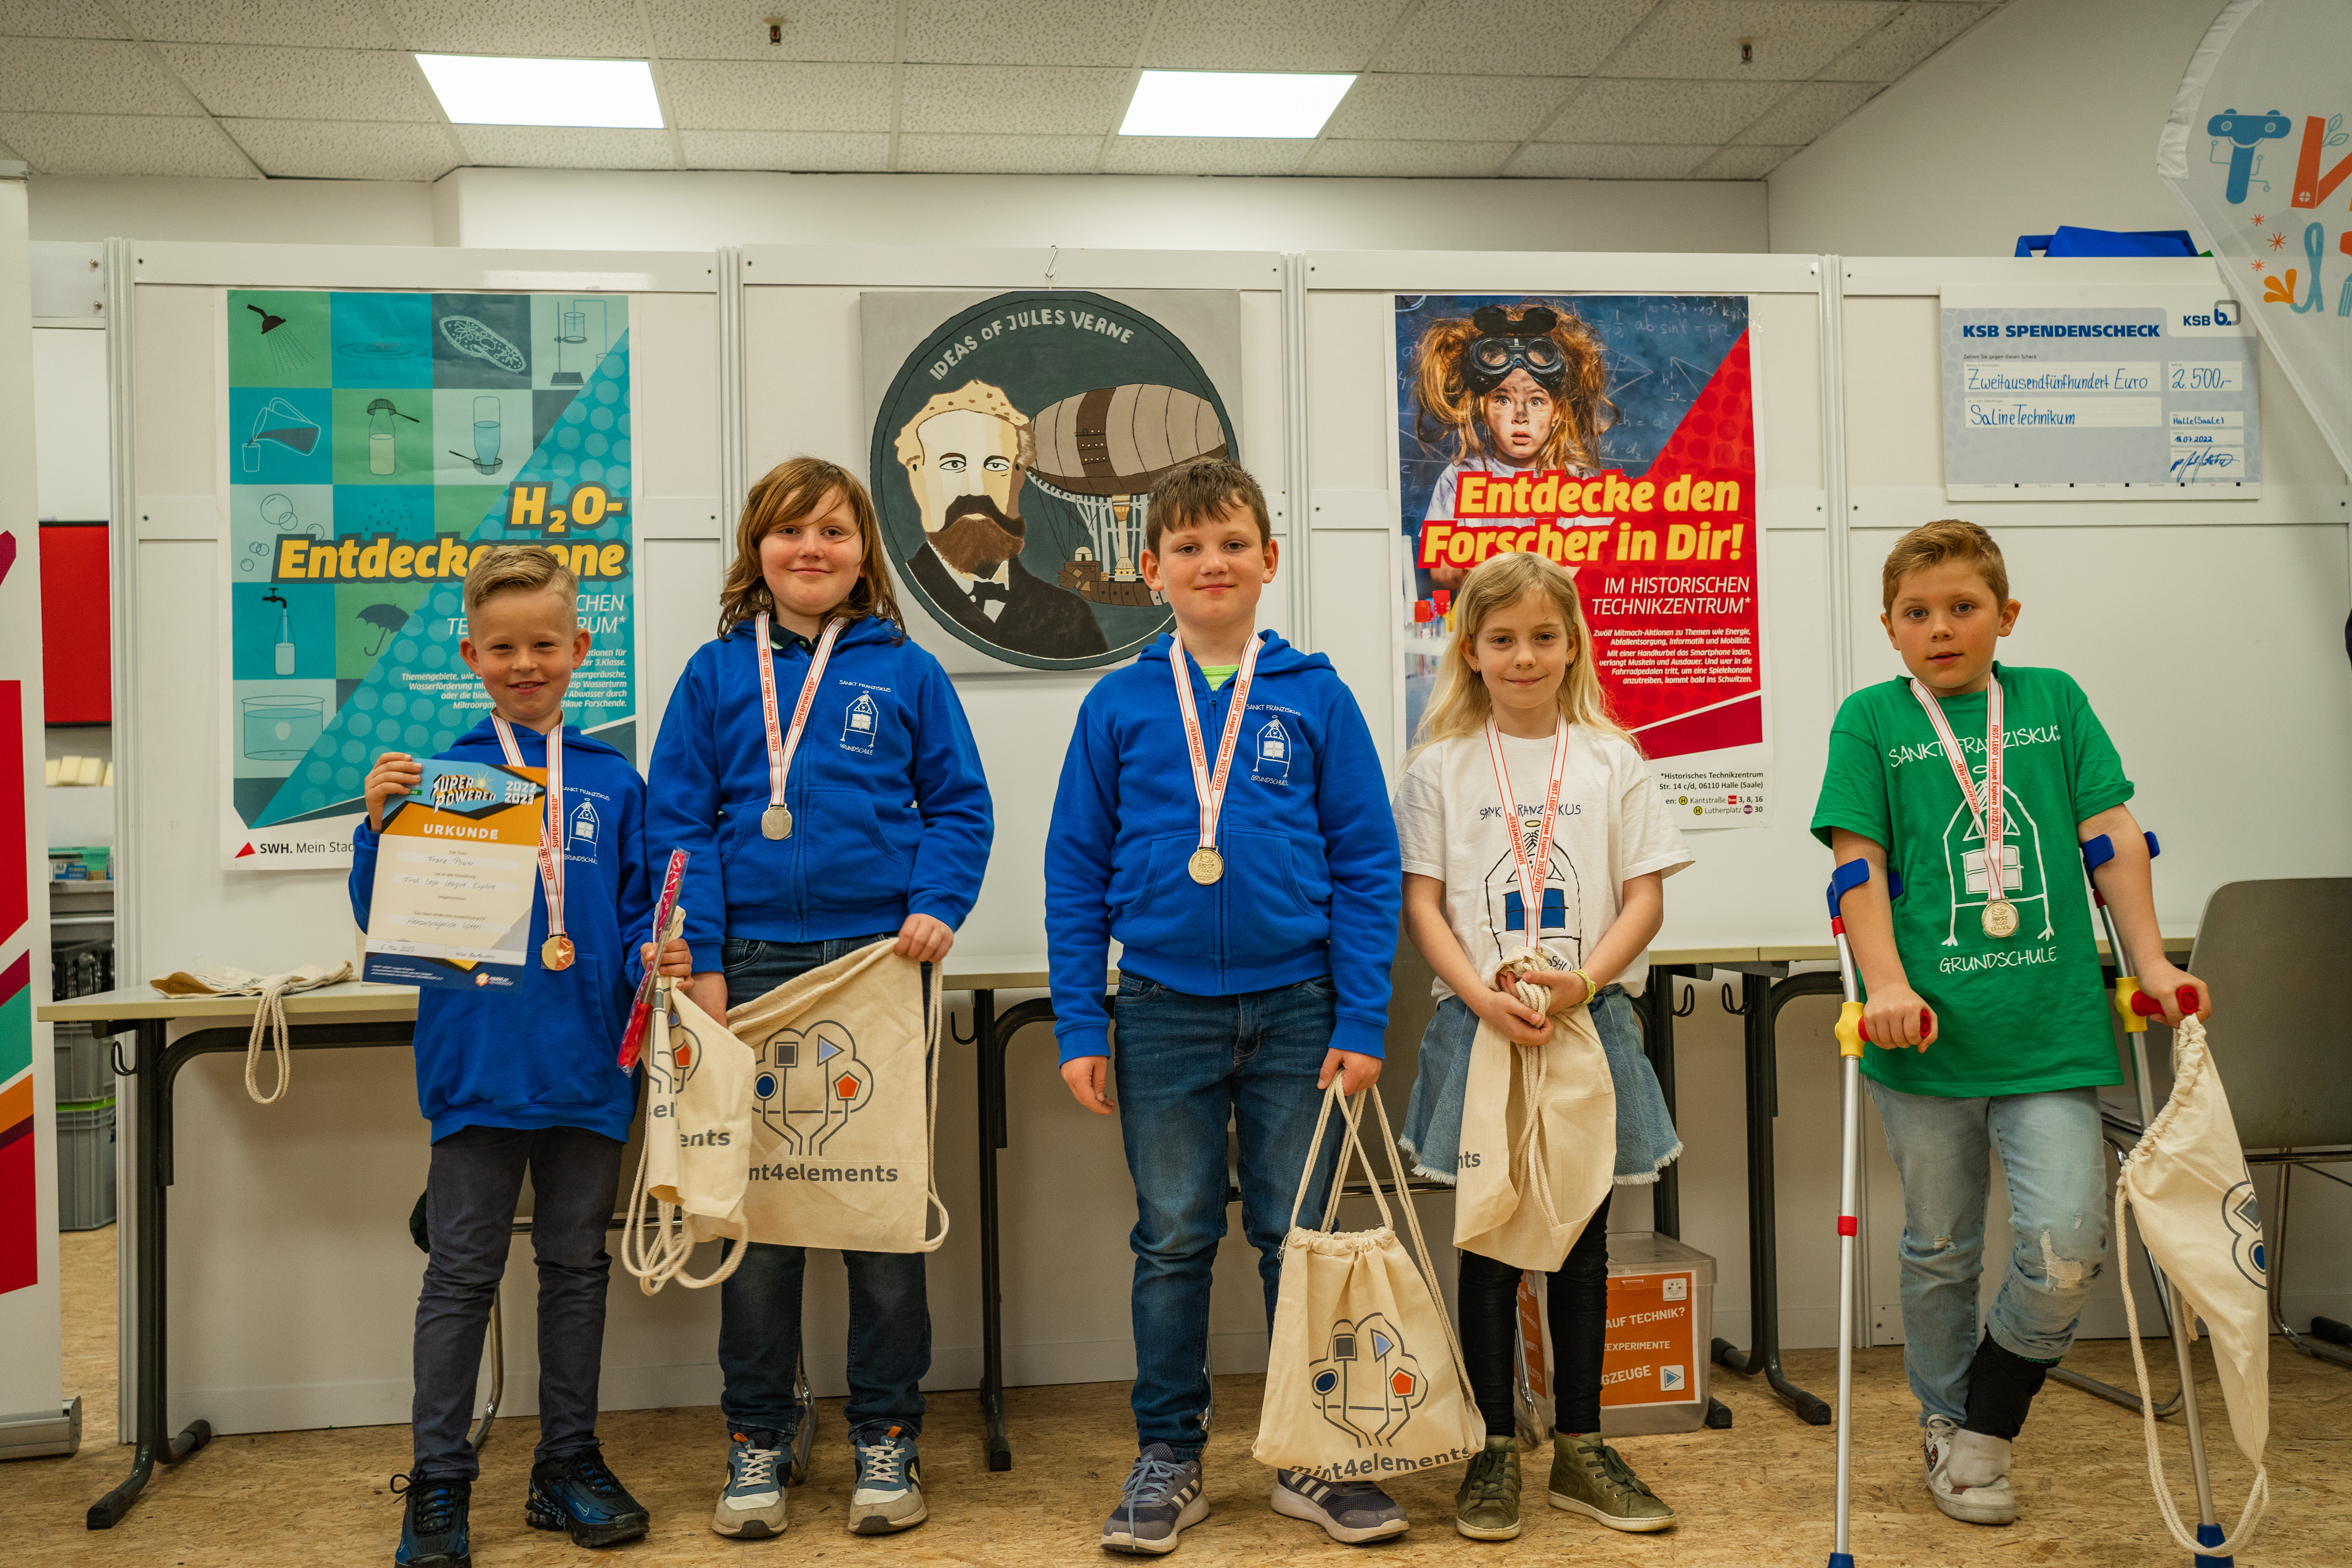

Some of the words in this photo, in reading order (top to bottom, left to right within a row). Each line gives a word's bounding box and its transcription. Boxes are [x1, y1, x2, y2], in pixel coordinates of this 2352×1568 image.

[2183, 316, 2210, 326] KSB
[1963, 325, 1999, 337] KSB
[2006, 325, 2160, 337] SPENDENSCHECK
[929, 336, 978, 380] IDEAS
[981, 320, 1003, 340] OF
[1006, 309, 1065, 330] JULES
[1070, 310, 1134, 343] VERNE
[1968, 368, 2109, 390] Zweitausendfünfhundert
[2114, 368, 2147, 389] Euro
[1459, 477, 1653, 514] Entdecke
[1664, 474, 1739, 512] den
[1424, 524, 1609, 563] Forscher
[1617, 522, 1656, 561] in
[1666, 522, 1743, 561] Dir!
[1604, 577, 1624, 594] IM
[1631, 576, 1749, 593] HISTORISCHEN
[1725, 628, 1751, 636] Energie,
[1690, 648, 1731, 657] Smartphone
[402, 672, 459, 681] Themengebiete,
[572, 671, 626, 679] assergeräusche,
[1709, 666, 1752, 675] Spielekonsole
[409, 682, 472, 690] Wasserförderung
[858, 683, 891, 693] FRANZISKUS
[1266, 705, 1301, 716] FRANZISKUS
[1228, 713, 1239, 735] League
[769, 722, 778, 751] 2022/2023
[840, 743, 873, 755] GRUNDSCHULE
[1222, 736, 1233, 758] Explore
[1888, 741, 1944, 768] SANKT
[1215, 759, 1228, 791] 2022/2023
[1251, 775, 1288, 786] GRUNDSCHULE
[430, 773, 474, 799] SUPER
[506, 780, 537, 793] 2022
[1740, 781, 1763, 789] (Saale)
[433, 790, 497, 813] POWERED
[505, 792, 535, 805] 2023
[580, 789, 610, 801] FRANZISKUS
[1480, 806, 1502, 820] SANK
[423, 824, 499, 840] URKUNDE
[1544, 814, 1553, 835] League
[260, 843, 292, 854] SWH.
[297, 842, 325, 853] Mein
[1539, 837, 1549, 859] Explore
[427, 856, 448, 864] Franz
[453, 857, 474, 867] Power
[541, 848, 553, 880] 2022/2023
[425, 878, 439, 887] Lego
[445, 879, 466, 890] League
[472, 881, 496, 891] Explore
[1534, 860, 1545, 893] 2022/2023
[1940, 946, 2057, 974] GRUNDSCHULE
[749, 1163, 898, 1182] nt4elements
[1606, 1316, 1627, 1329] AUF
[1629, 1307, 1685, 1325] TECHNIK?
[1601, 1365, 1651, 1385] GZEUGE
